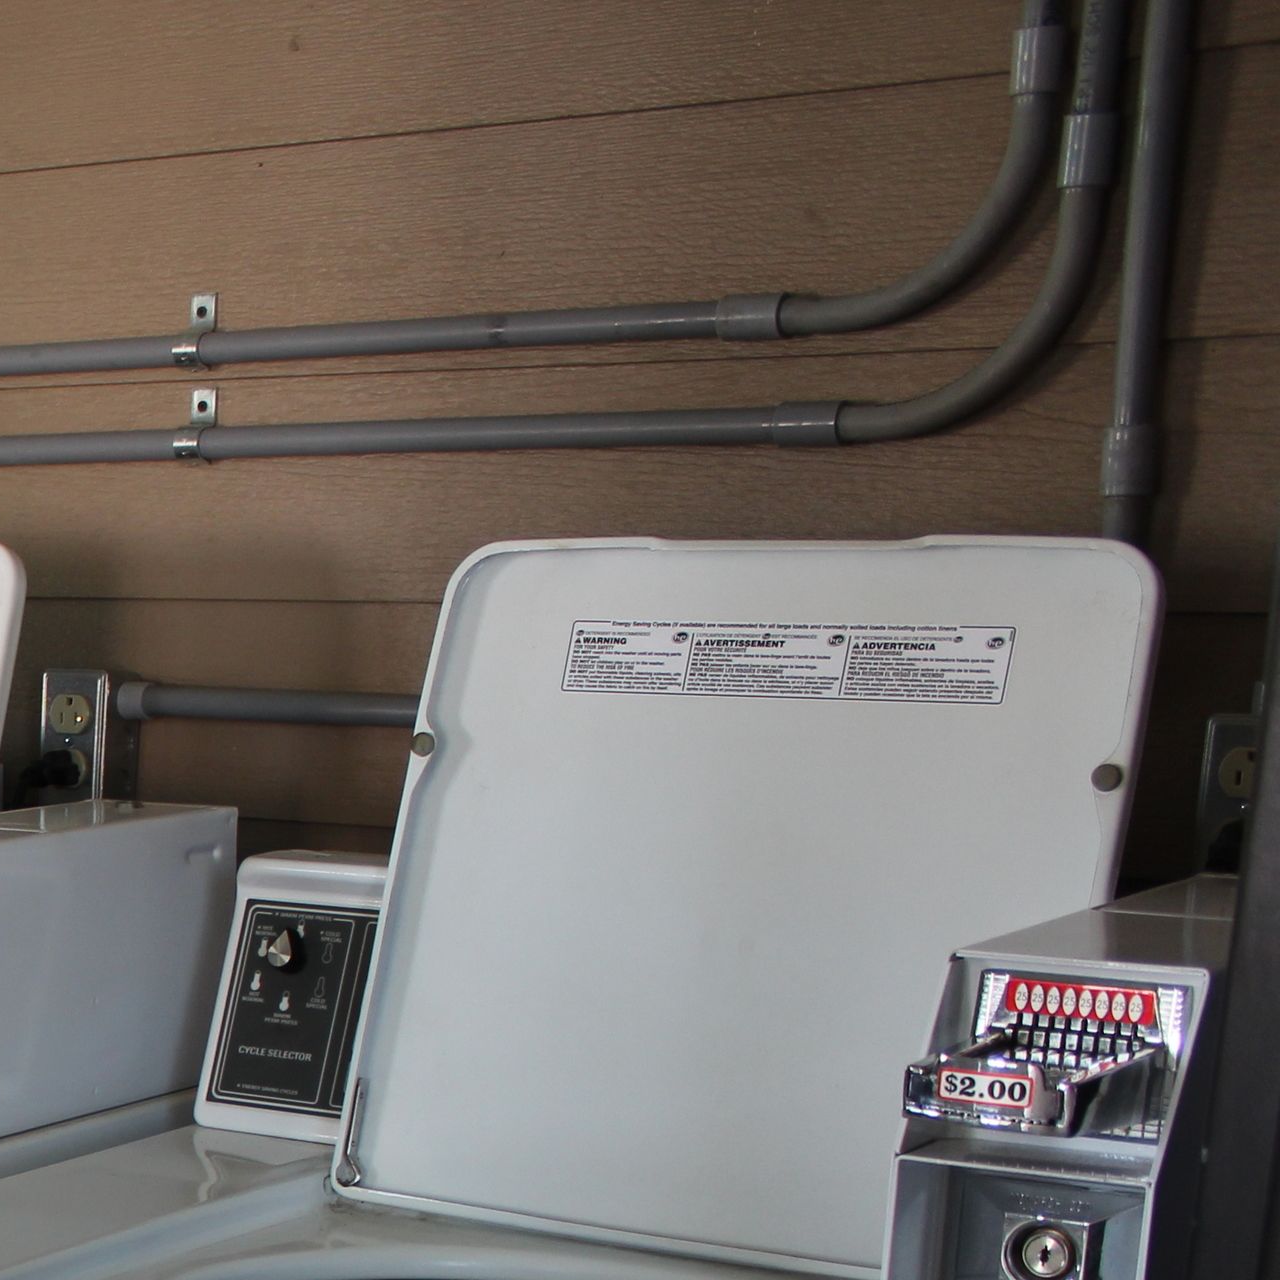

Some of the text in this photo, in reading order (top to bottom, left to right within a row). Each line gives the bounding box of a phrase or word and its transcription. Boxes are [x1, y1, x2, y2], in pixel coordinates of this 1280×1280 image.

[583, 637, 627, 645] WARNING
[703, 639, 786, 648] AVERTISSEMENT
[861, 642, 936, 650] ADVERTENCIA
[238, 1045, 313, 1062] CYCLE SELECTOR
[943, 1073, 1027, 1102] $2.00
